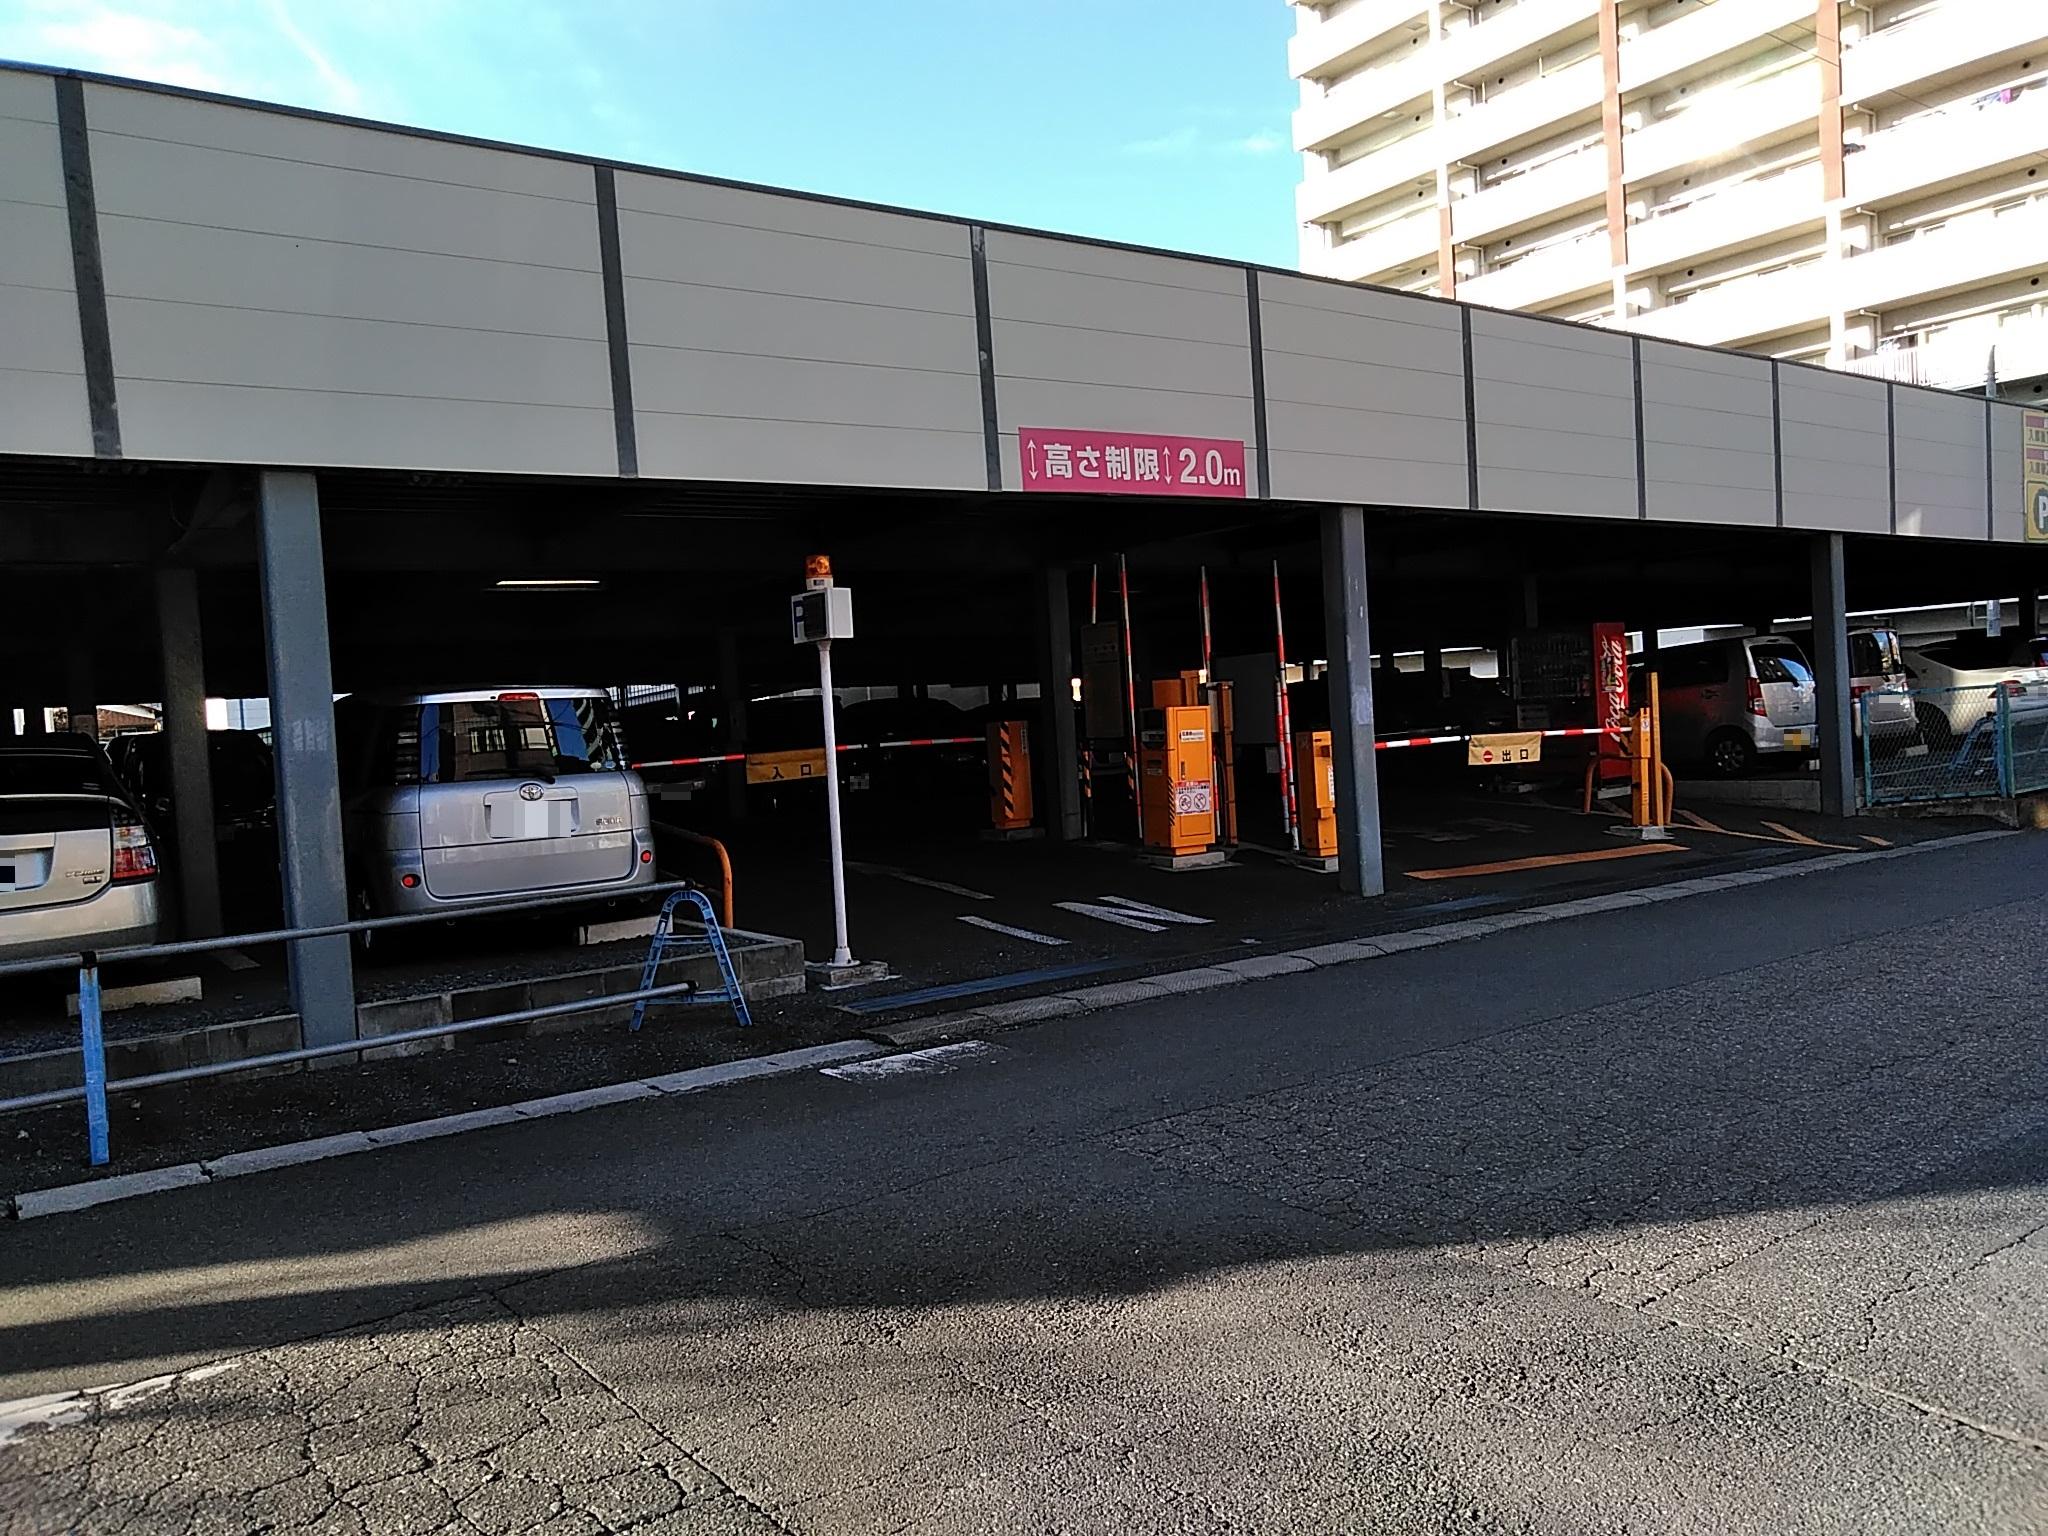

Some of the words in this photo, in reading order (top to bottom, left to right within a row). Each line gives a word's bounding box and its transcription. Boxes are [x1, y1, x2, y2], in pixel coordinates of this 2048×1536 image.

[1043, 443, 1160, 481] 高さ制限
[1179, 447, 1241, 486] 2.0m
[1502, 748, 1529, 762] 出口
[773, 764, 811, 779] 入口
